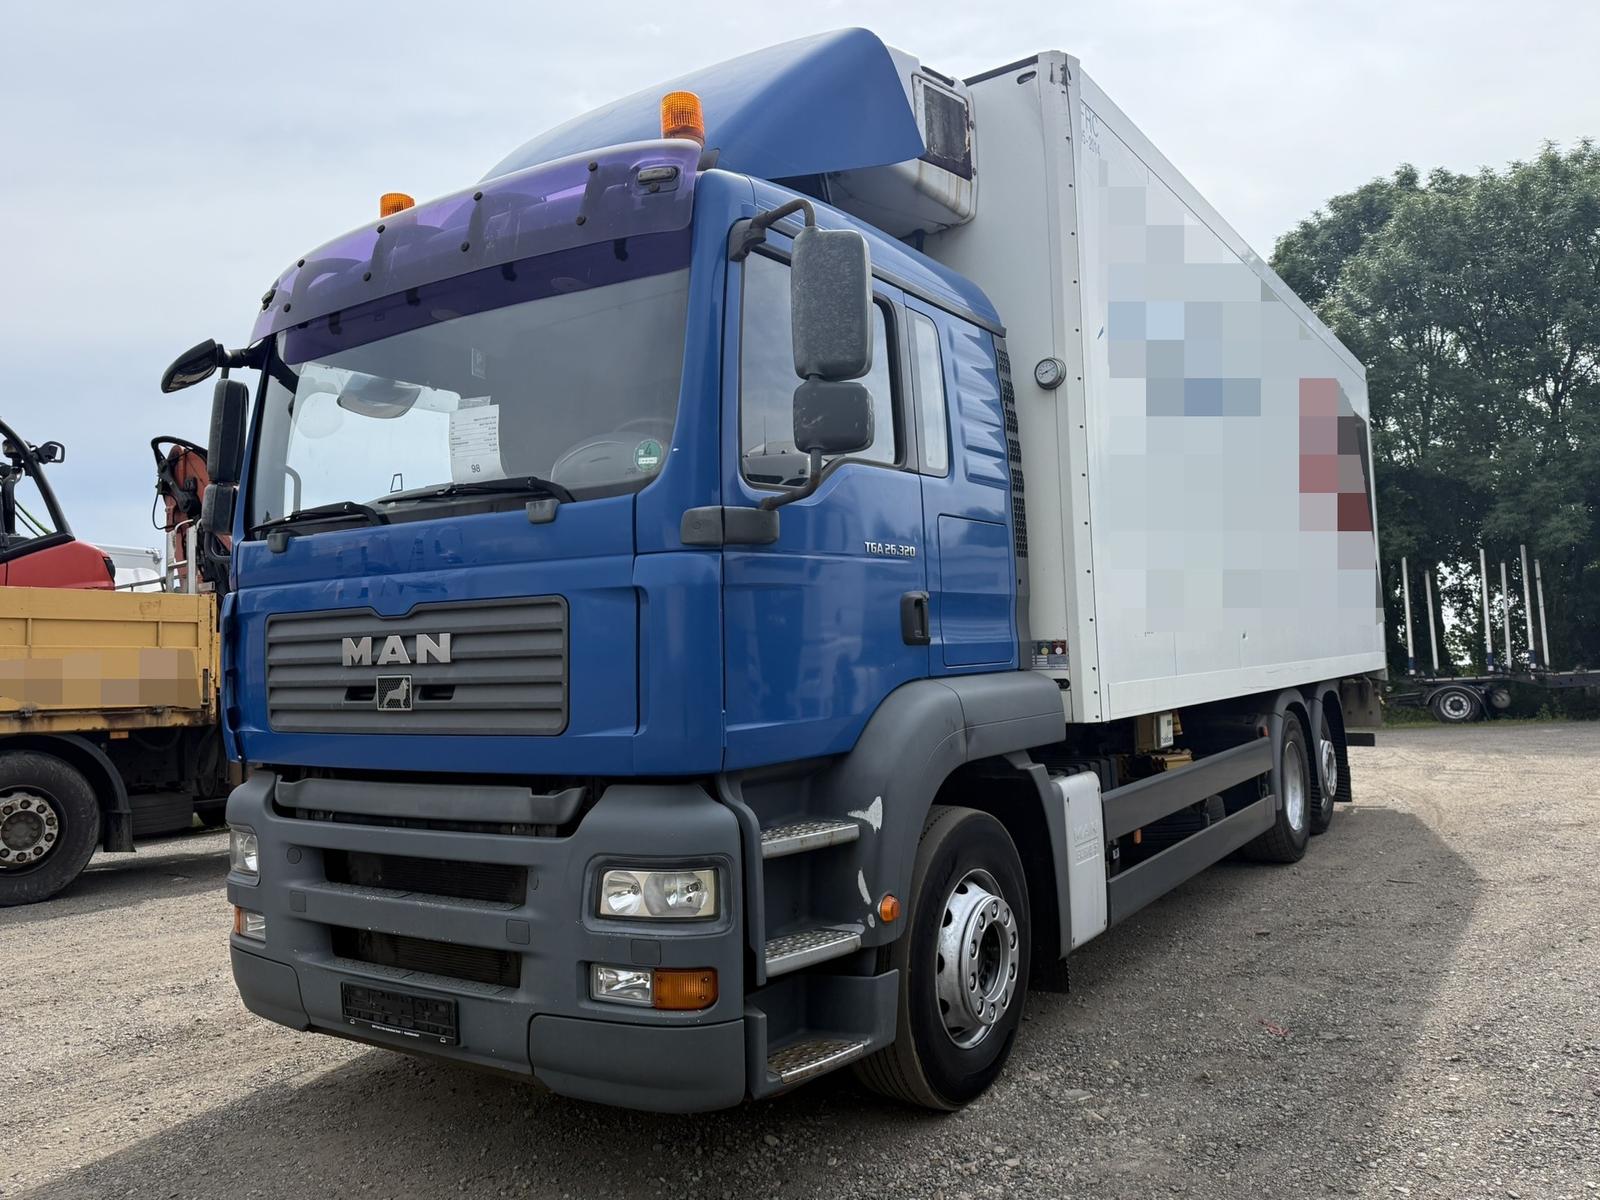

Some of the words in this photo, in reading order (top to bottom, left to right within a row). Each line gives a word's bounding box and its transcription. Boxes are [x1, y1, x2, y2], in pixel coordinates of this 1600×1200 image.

[471, 464, 481, 473] 98
[864, 541, 884, 553] TGA
[885, 543, 916, 557] 26.320
[341, 632, 452, 667] MAN
